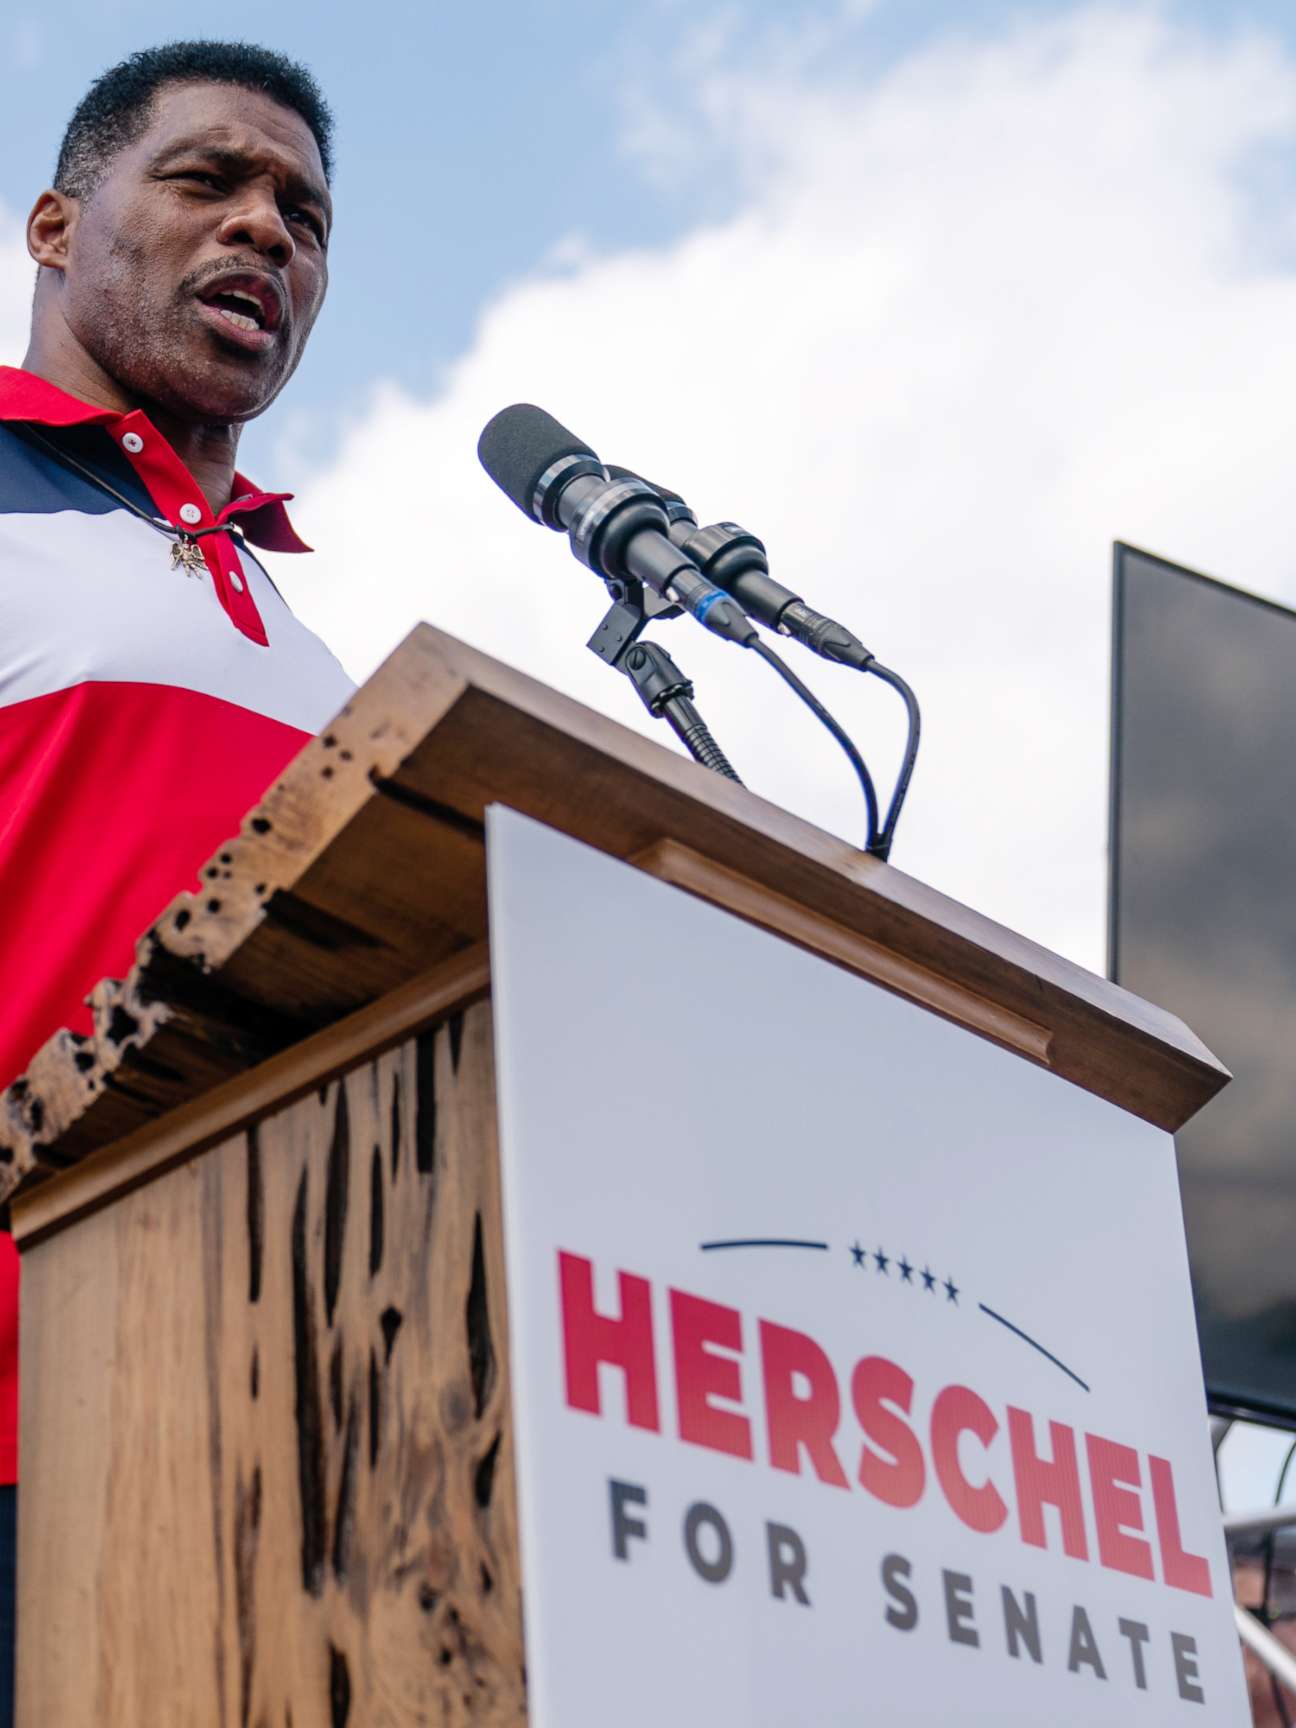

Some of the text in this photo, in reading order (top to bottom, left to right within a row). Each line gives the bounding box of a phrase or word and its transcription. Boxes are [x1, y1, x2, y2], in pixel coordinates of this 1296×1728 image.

[556, 1247, 1213, 1599] HERSCHEL
[608, 1477, 1206, 1705] FOR SENATE
